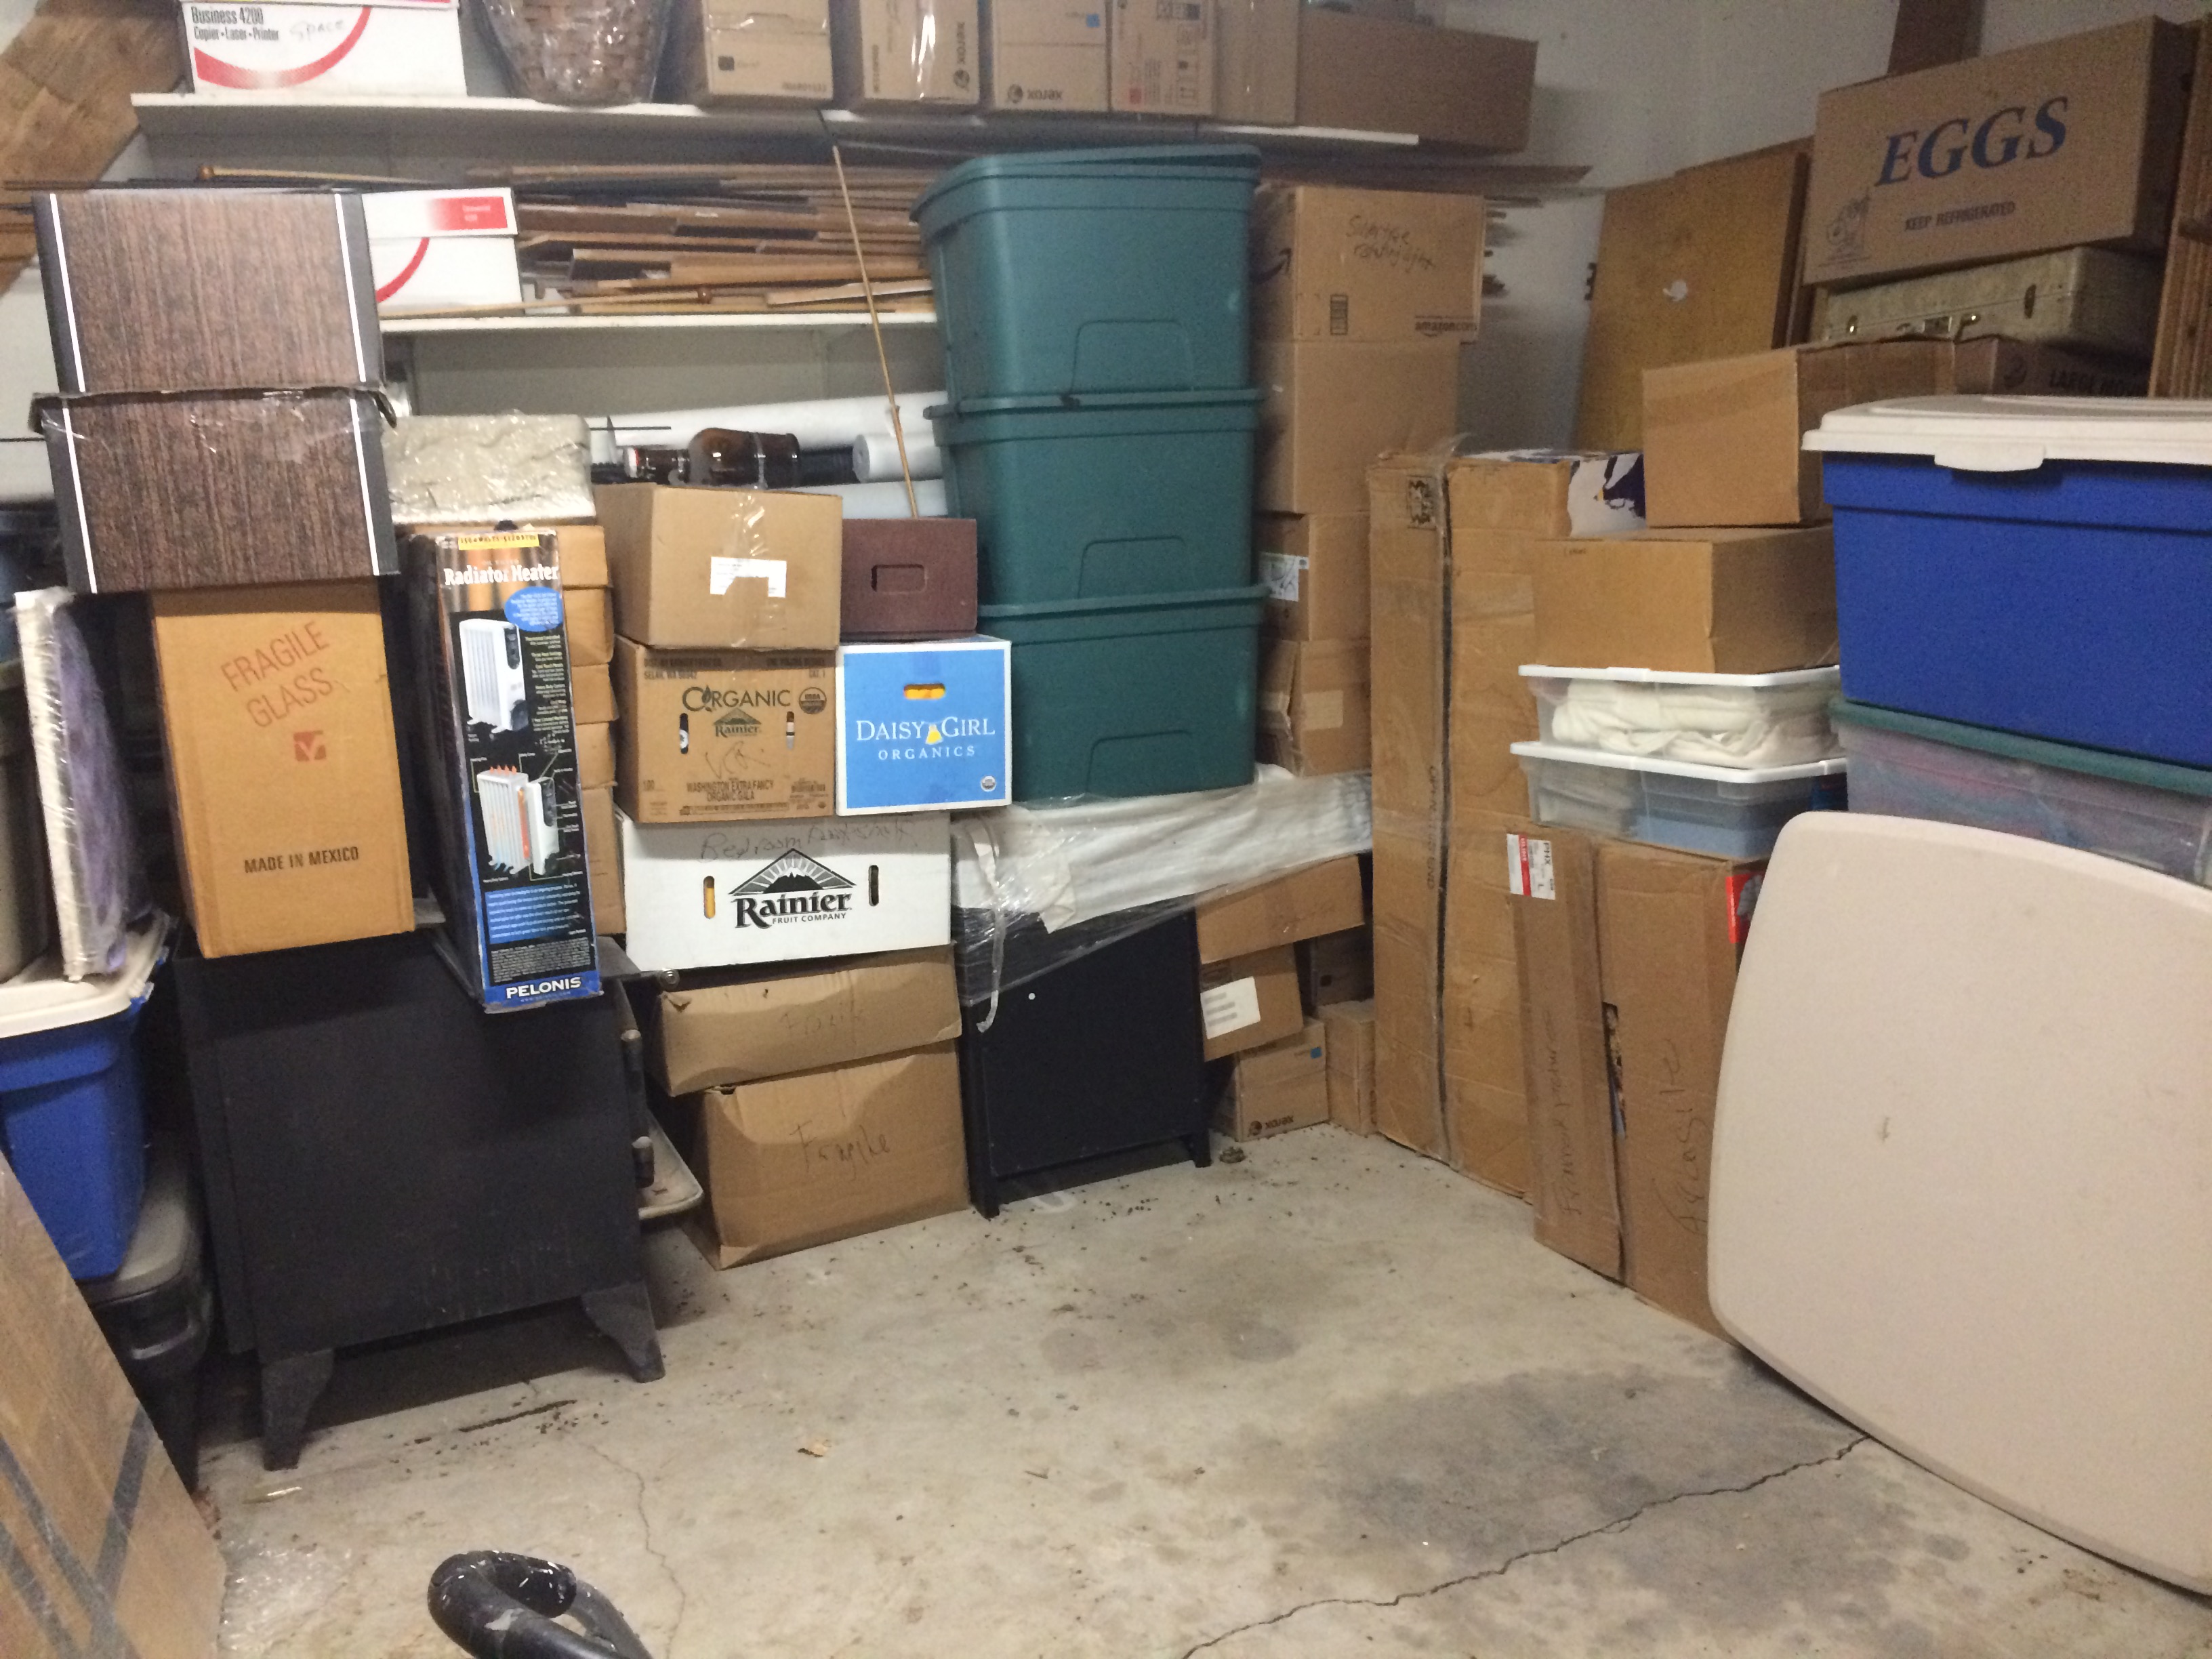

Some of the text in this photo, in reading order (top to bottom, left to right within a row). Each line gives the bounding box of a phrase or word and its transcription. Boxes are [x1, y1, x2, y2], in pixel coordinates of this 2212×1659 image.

[191, 7, 264, 24] Business 4200
[194, 26, 279, 41] Copier Laser Printer
[1875, 96, 2067, 186] EGGS
[1905, 201, 2016, 231] KEEP REFRIGERATED
[443, 563, 559, 586] Radiator Heater
[220, 621, 330, 692] FRAGILE
[247, 668, 333, 727] GLASS
[682, 686, 790, 712] ORGANIC
[715, 724, 759, 738] Rainier
[857, 716, 995, 741] DAISY GIRL
[878, 745, 975, 760] ORGANICS
[687, 779, 774, 793] WASHINGTON EXTRA FANCY
[245, 846, 359, 873] MADE IN MEXICO
[731, 892, 852, 929] Rainier
[773, 913, 846, 924] FRUIT COMPANY
[506, 977, 581, 999] PELONIS
